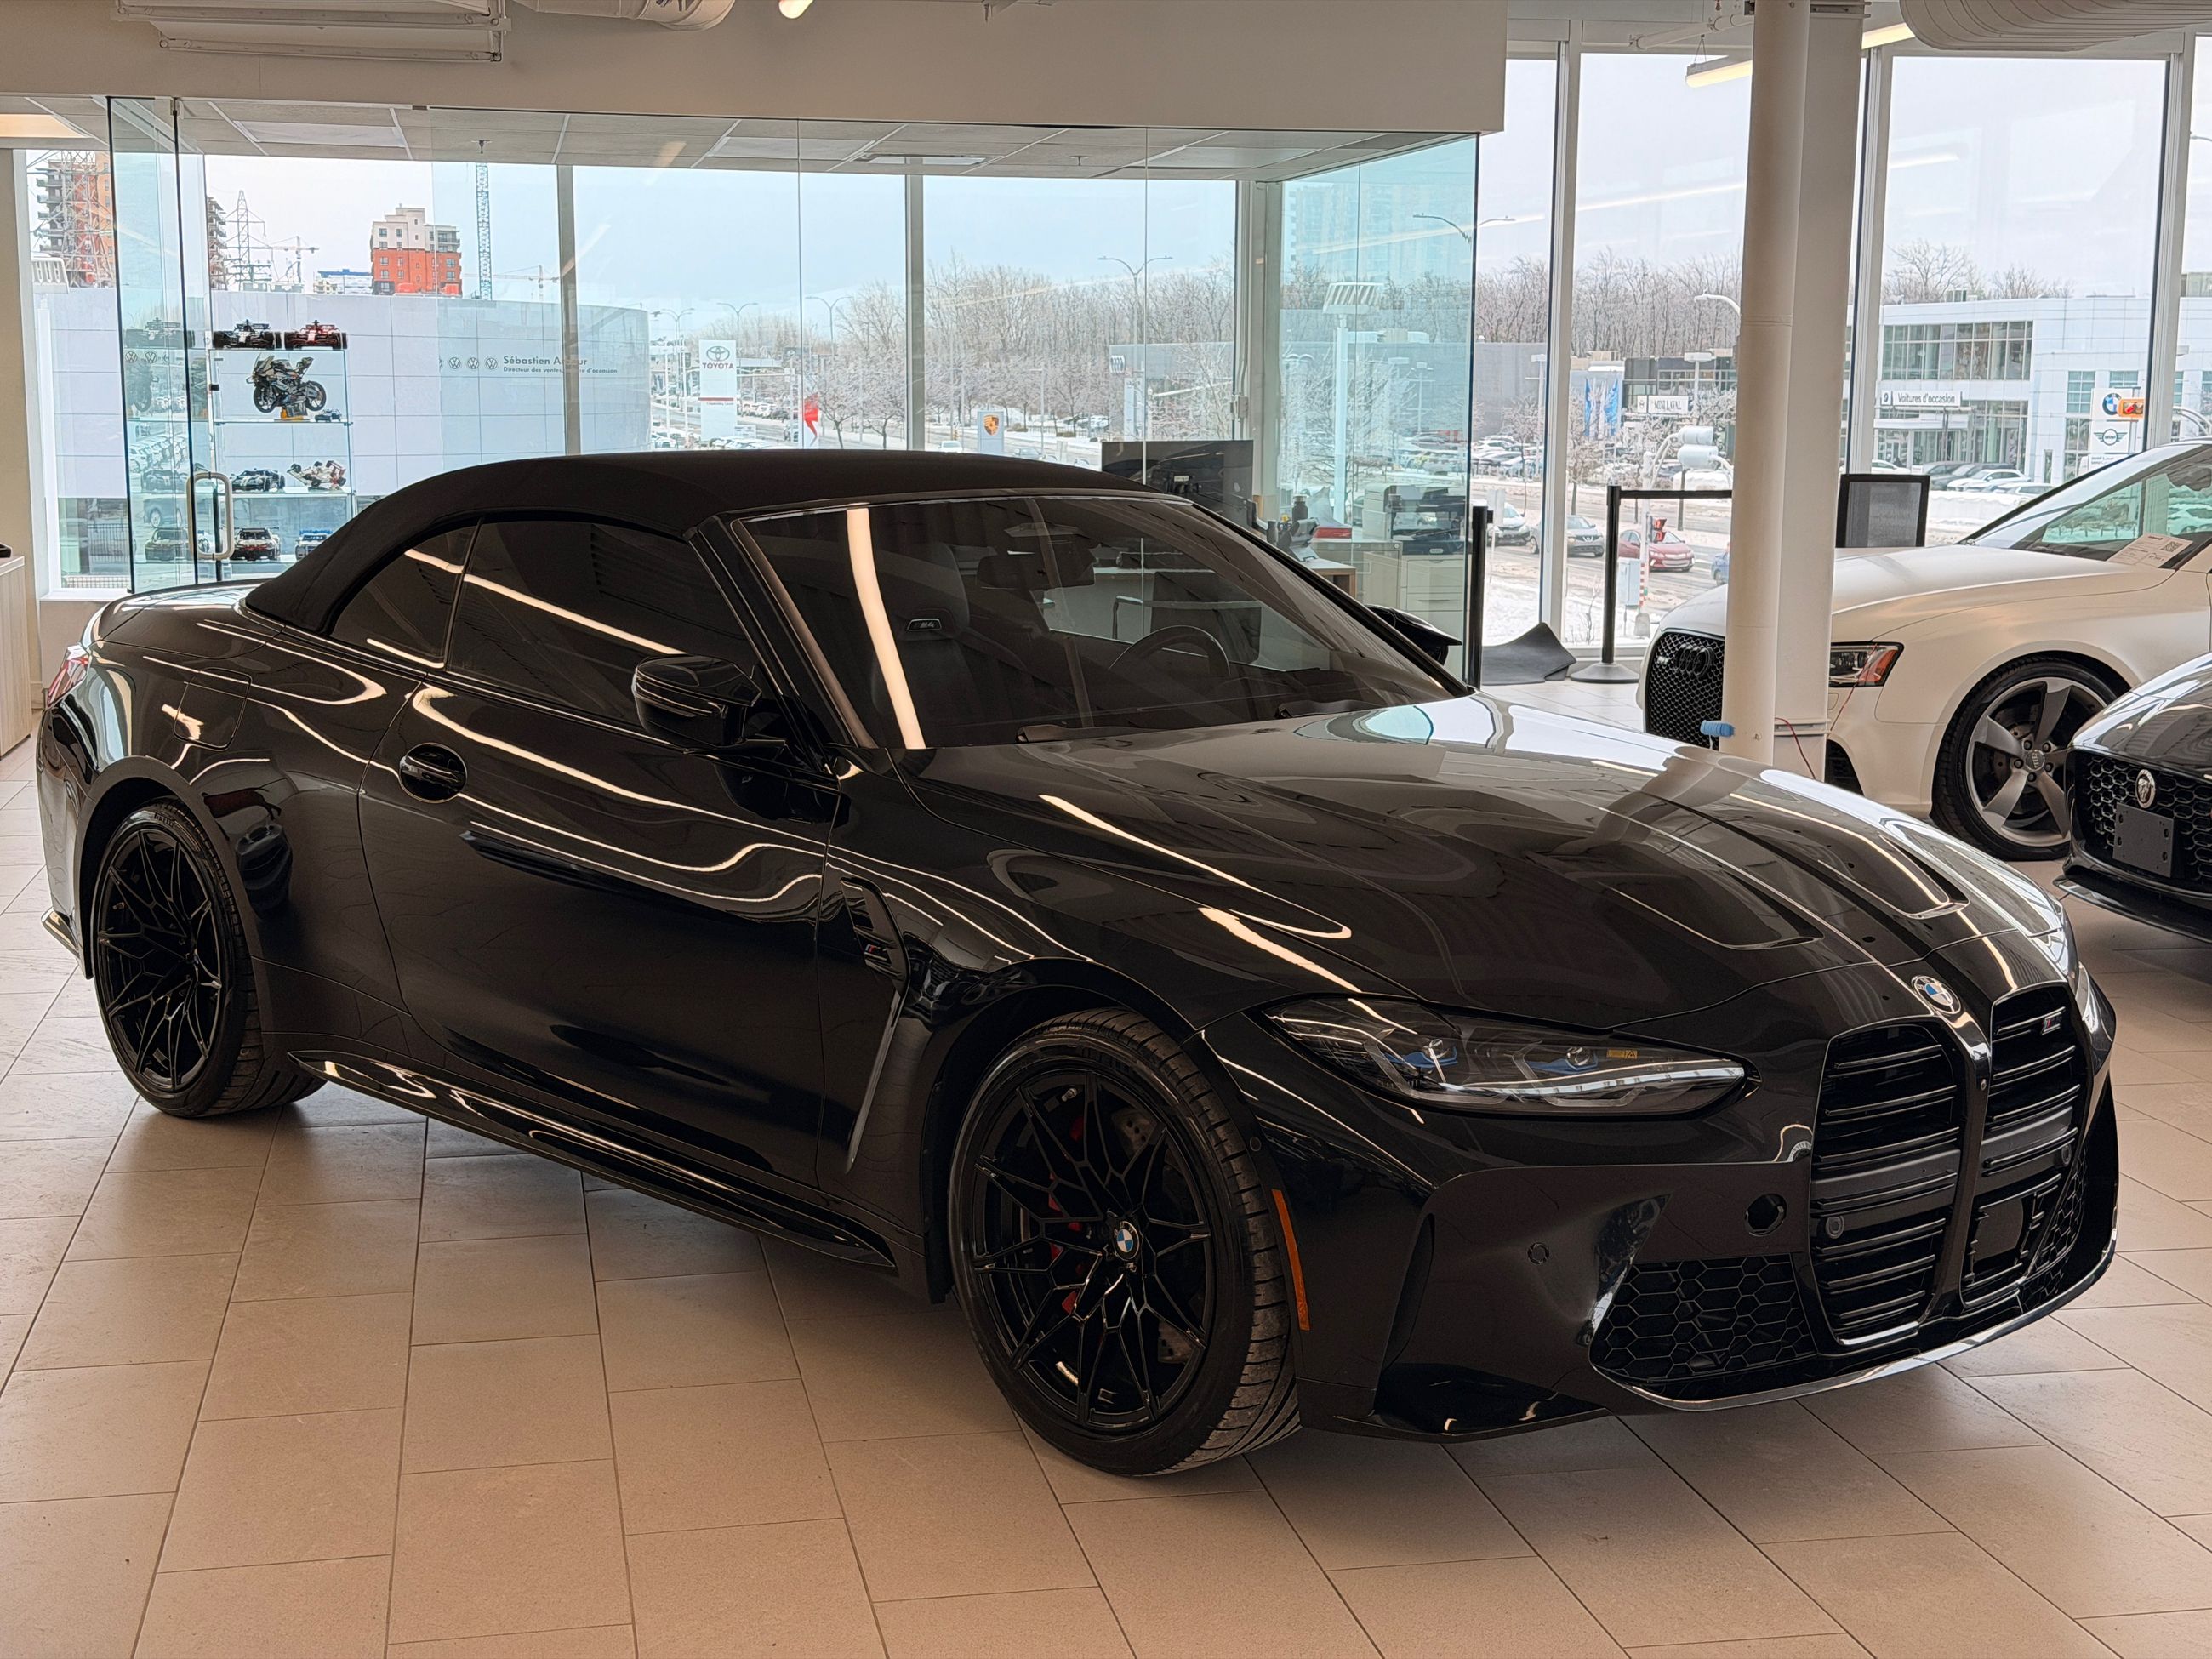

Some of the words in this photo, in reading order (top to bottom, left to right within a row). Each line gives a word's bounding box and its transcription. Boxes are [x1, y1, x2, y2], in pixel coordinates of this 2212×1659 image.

[503, 355, 550, 365] Sébastien
[1897, 392, 1921, 403] Voitures
[1923, 392, 1955, 403] d'occasion
